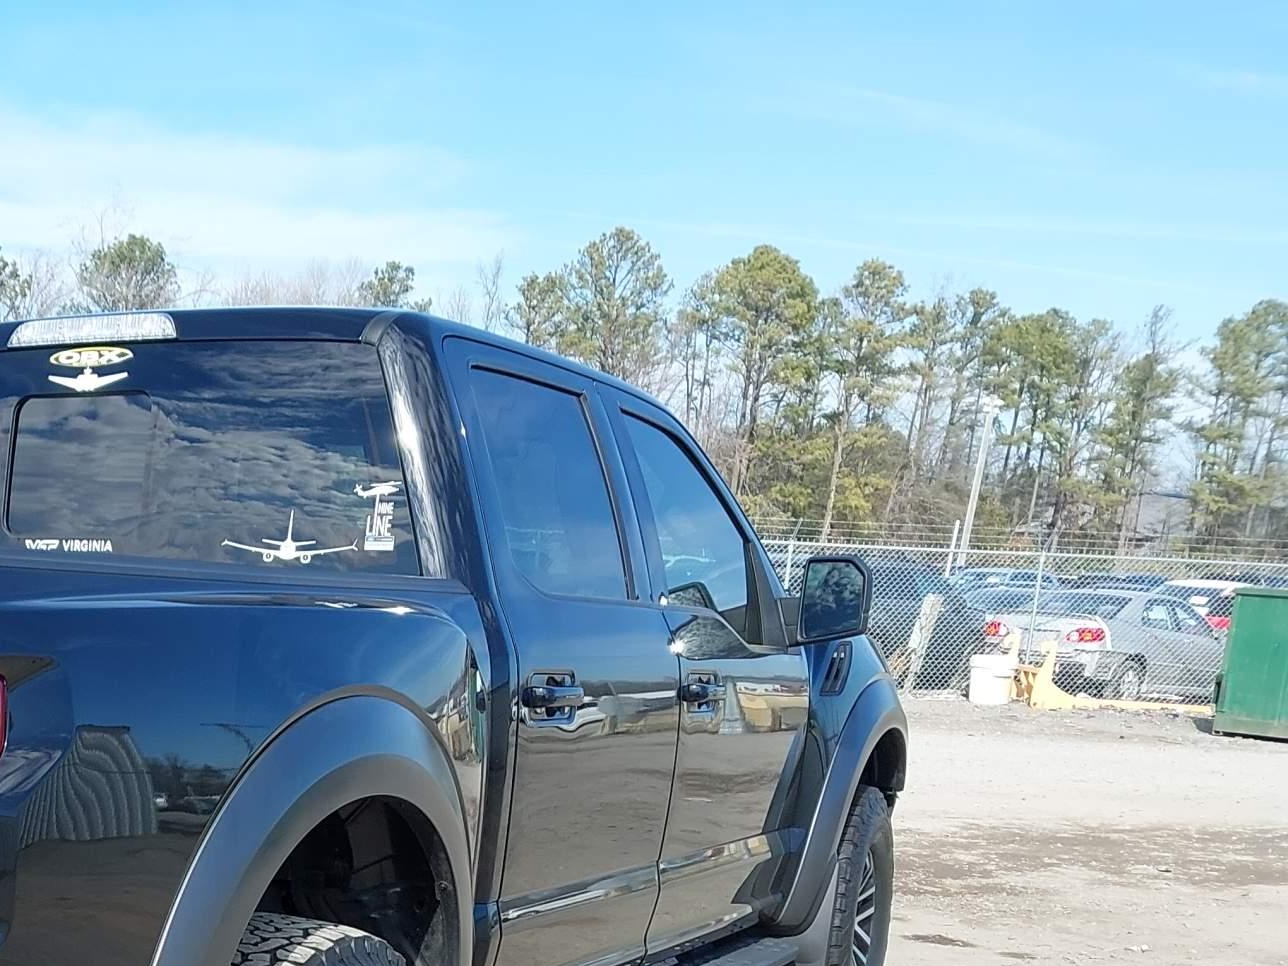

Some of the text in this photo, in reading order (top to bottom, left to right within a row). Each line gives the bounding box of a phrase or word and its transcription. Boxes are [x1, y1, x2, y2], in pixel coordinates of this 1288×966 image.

[58, 350, 122, 365] OBX
[377, 501, 395, 515] NINE
[365, 514, 394, 537] LINE
[62, 539, 113, 553] VIRGINIA
